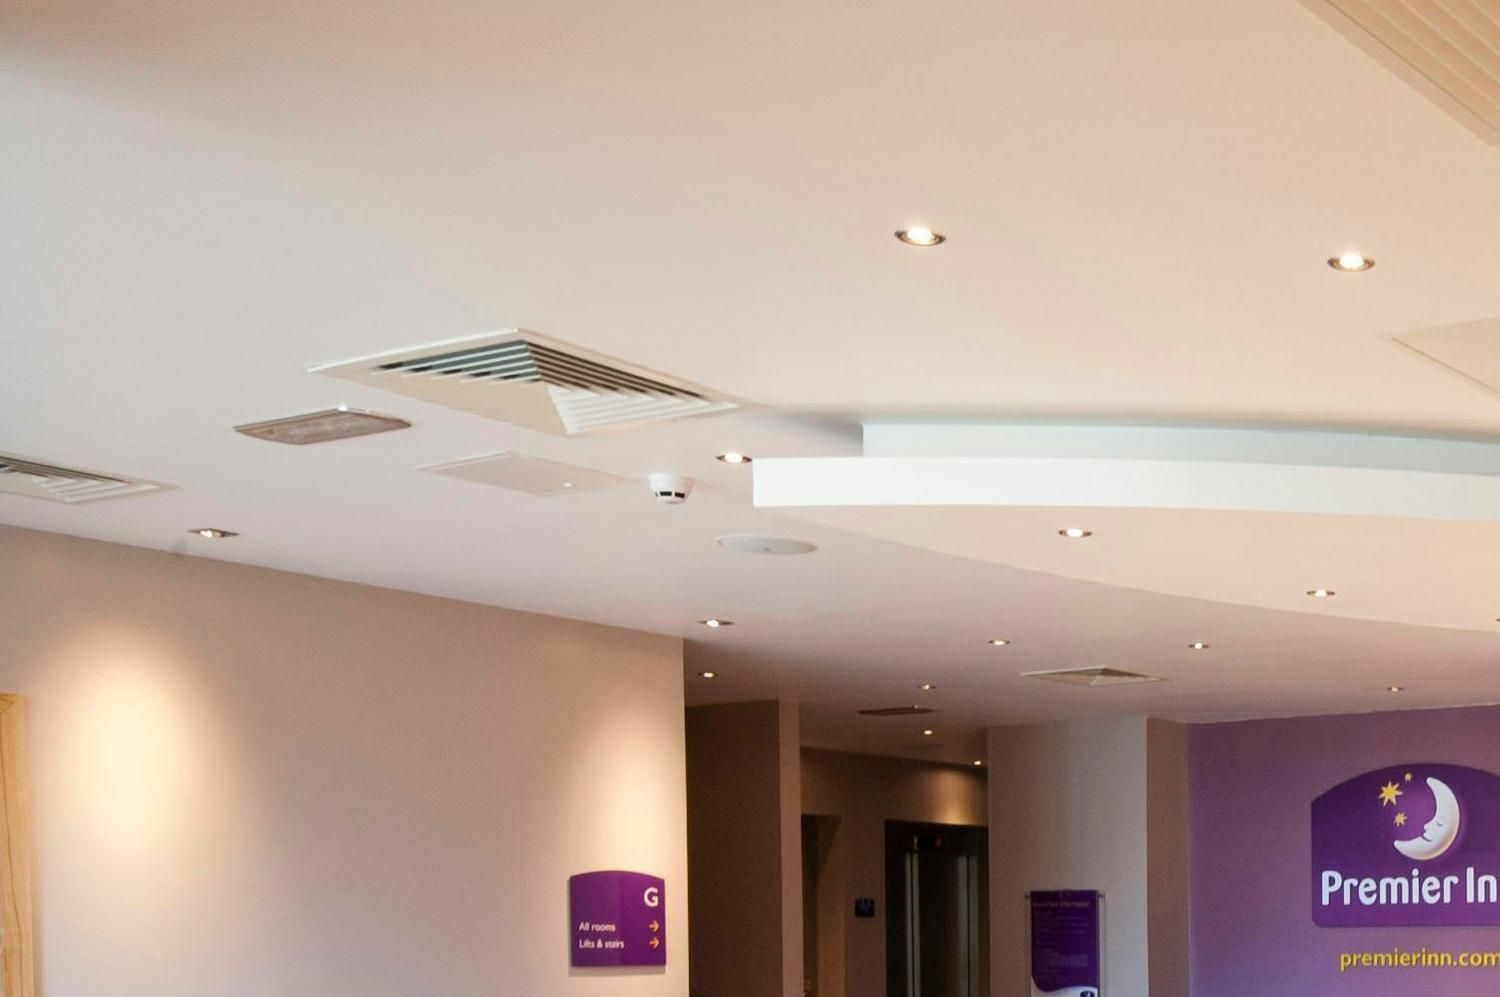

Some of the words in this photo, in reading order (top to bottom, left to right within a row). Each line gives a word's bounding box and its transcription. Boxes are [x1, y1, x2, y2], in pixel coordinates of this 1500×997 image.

[1321, 868, 1459, 906] Premier
[643, 887, 659, 907] G
[578, 922, 590, 931] All
[591, 924, 616, 932] rooms
[604, 939, 625, 949] stairs
